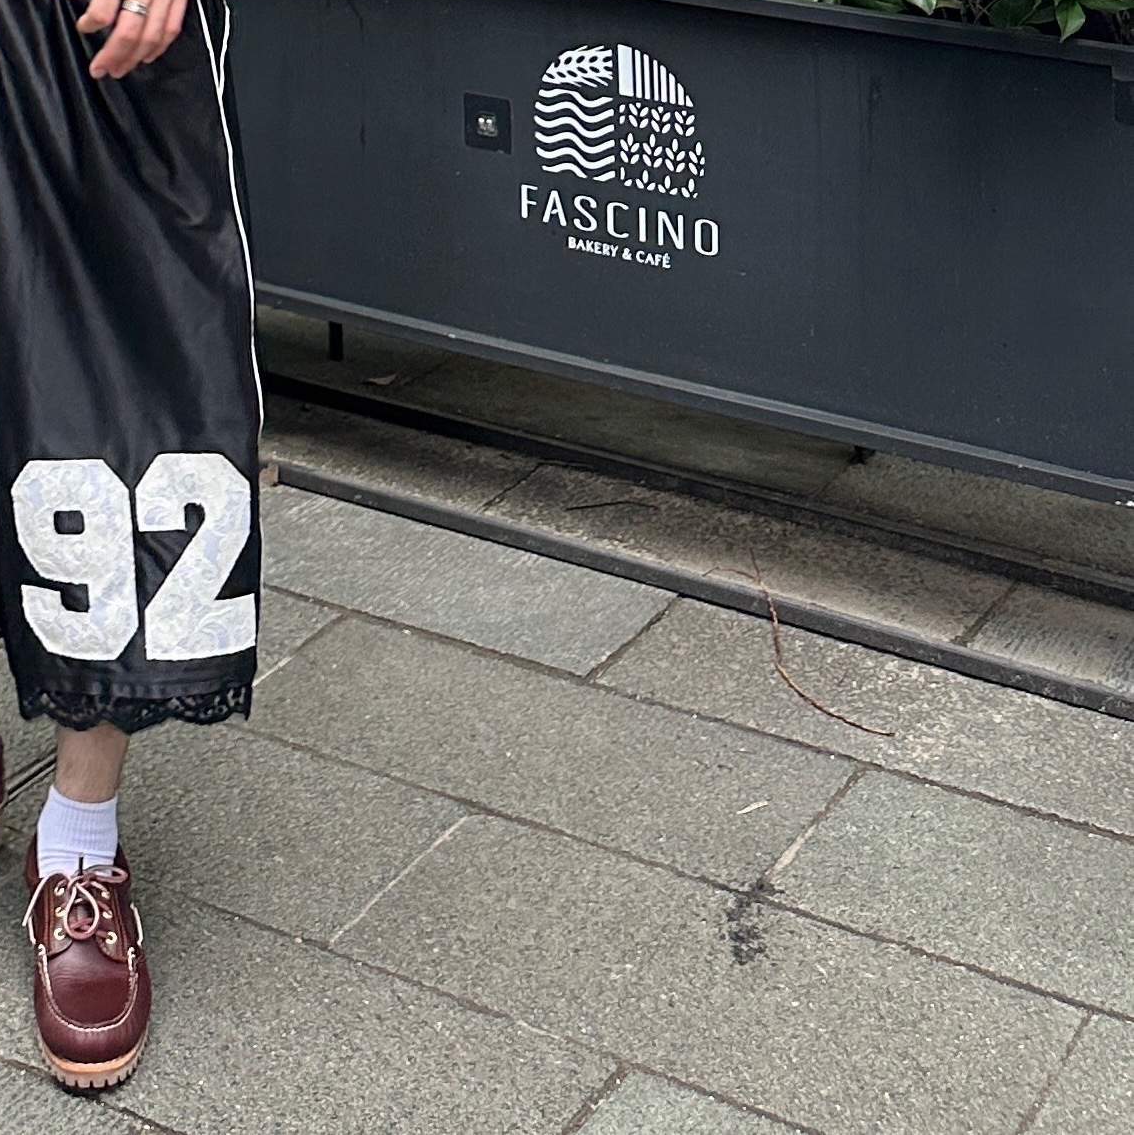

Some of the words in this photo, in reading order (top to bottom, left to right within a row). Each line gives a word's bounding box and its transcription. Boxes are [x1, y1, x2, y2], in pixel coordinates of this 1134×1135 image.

[520, 183, 719, 256] FASCINO
[568, 236, 618, 258] BAKERY
[621, 247, 633, 261] &
[635, 250, 672, 269] CAFÉ
[11, 453, 256, 661] 92
